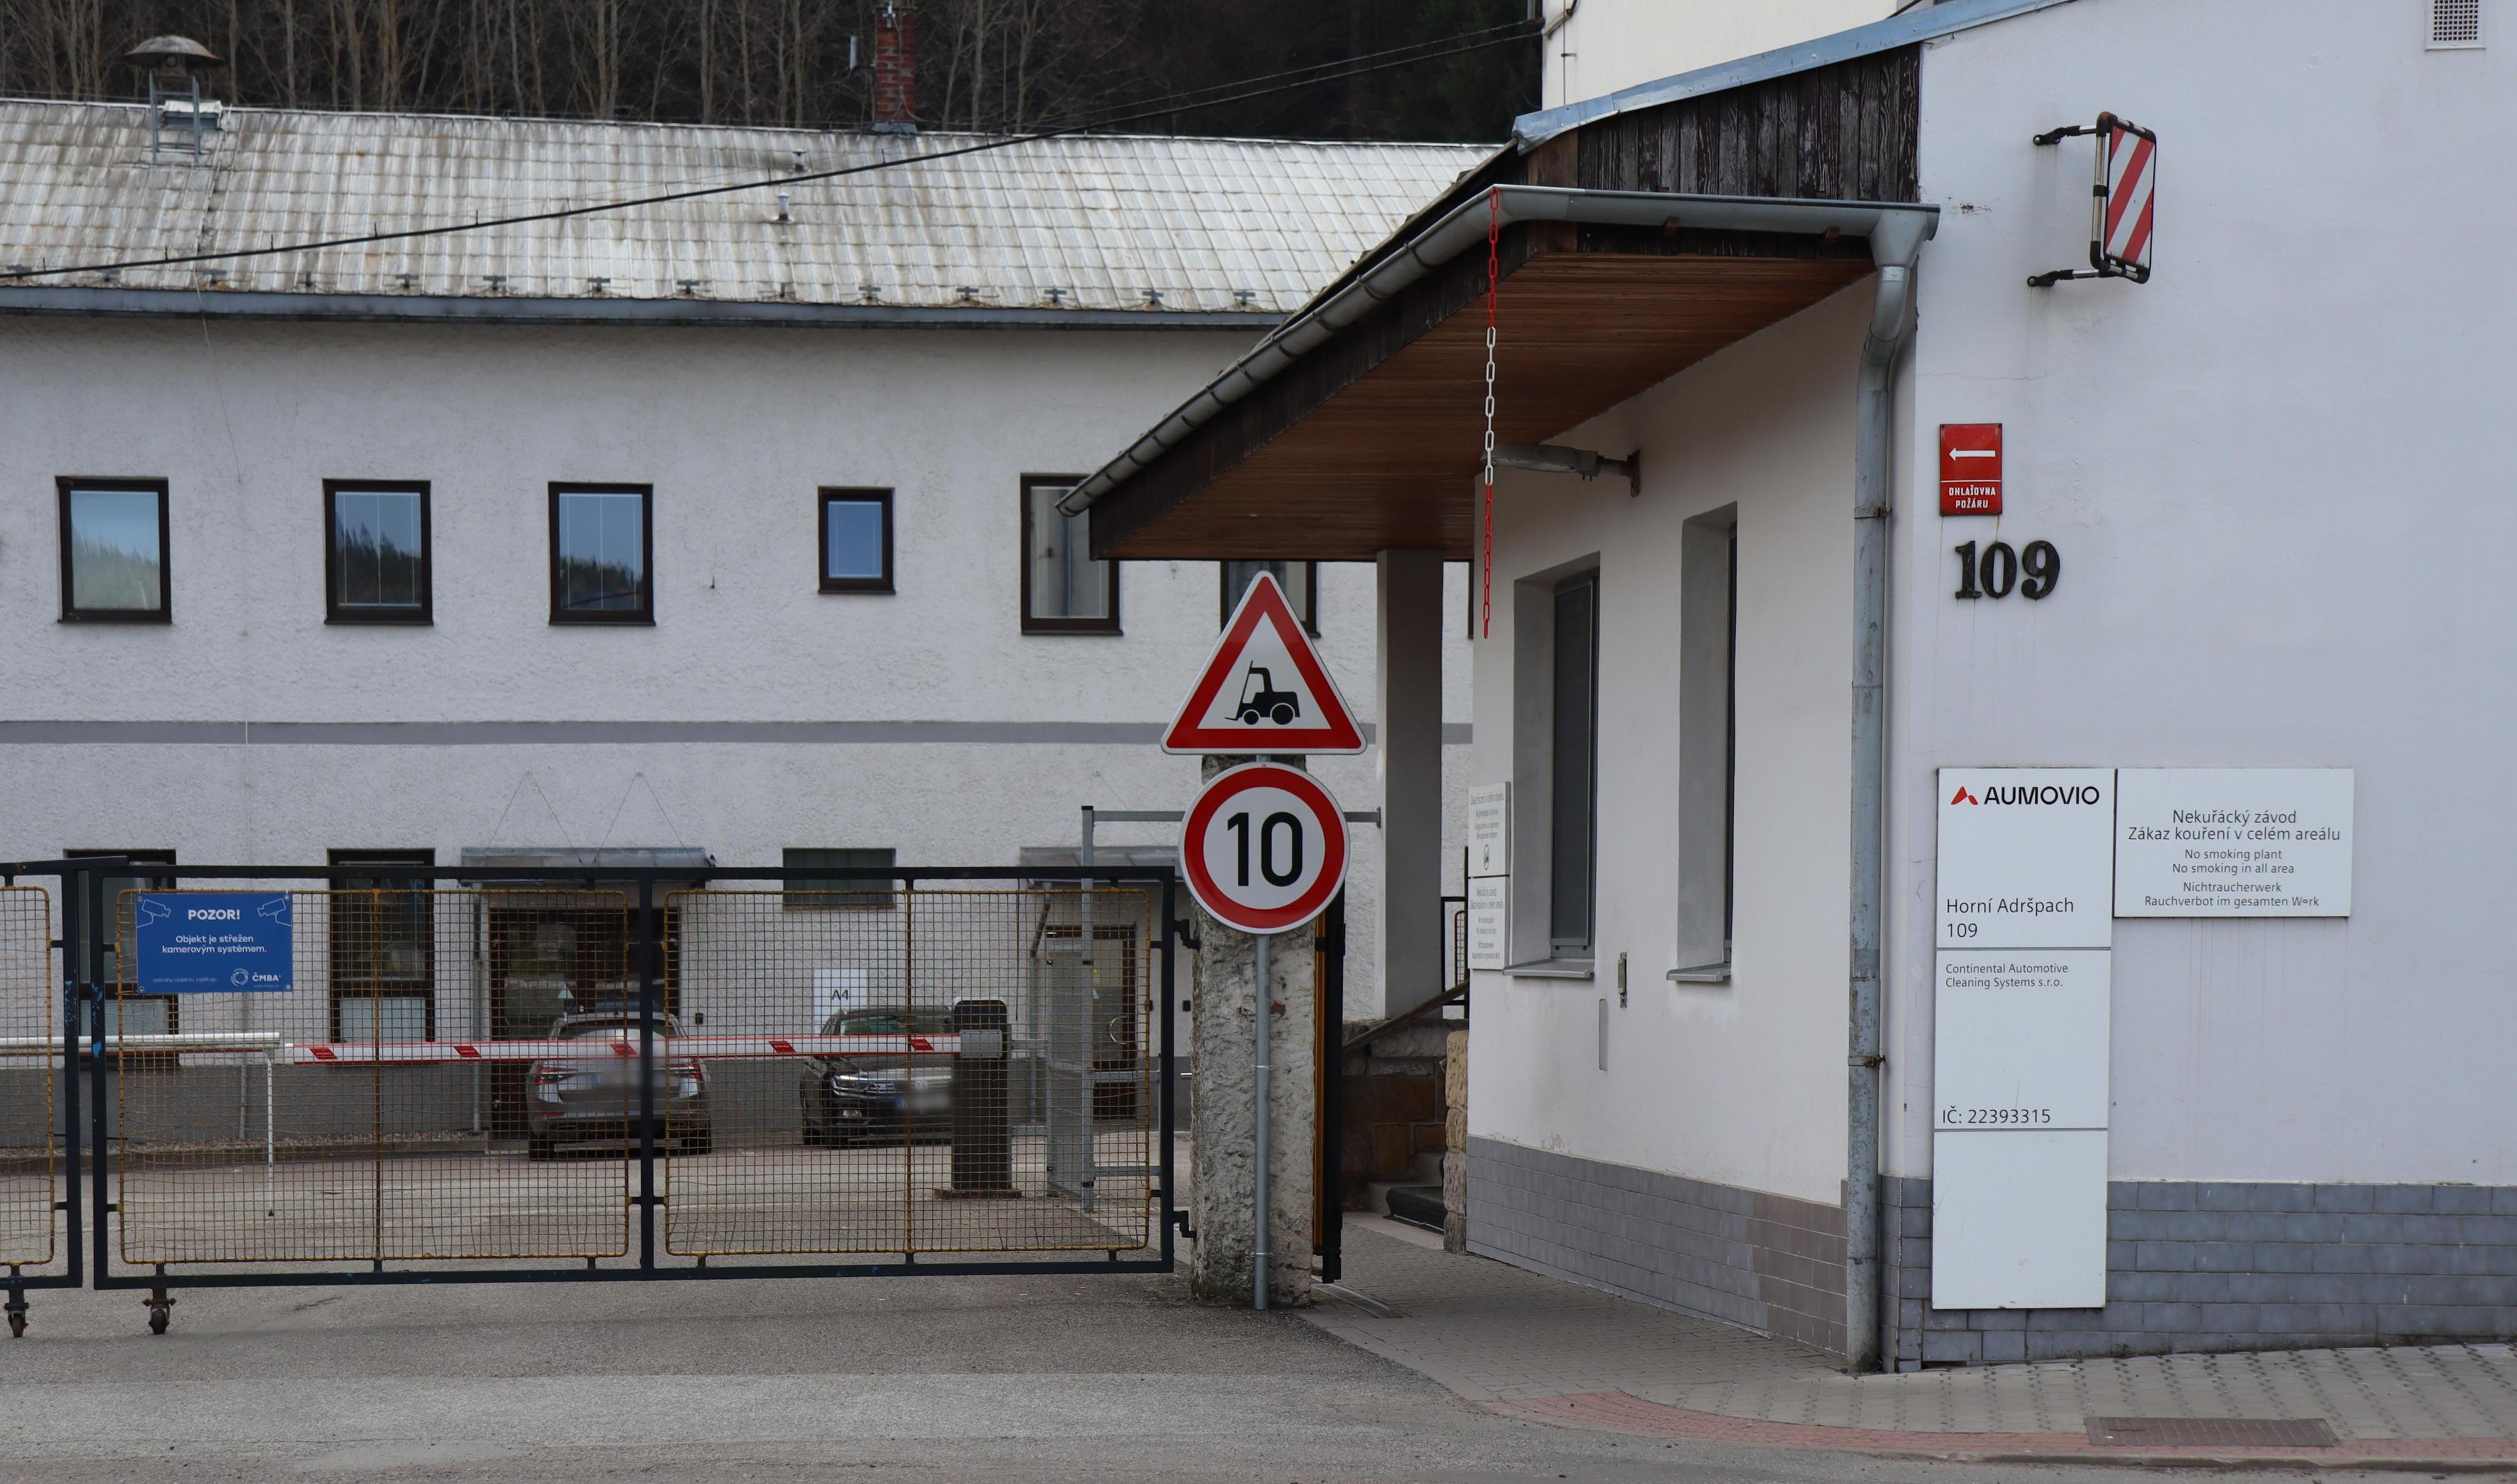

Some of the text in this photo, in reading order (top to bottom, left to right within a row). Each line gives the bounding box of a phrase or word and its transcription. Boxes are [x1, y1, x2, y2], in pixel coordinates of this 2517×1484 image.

[1949, 484, 1996, 496] OHLAŠOVNA
[1955, 497, 1988, 509] POŽÁRU
[1954, 540, 2061, 601] 109
[1983, 786, 2100, 805] AUMOVIO
[2173, 809, 2296, 827] Nekuřácký závod
[2128, 826, 2340, 840] Zákaz kouření v celém areálu
[1227, 812, 1303, 887] 10
[2185, 848, 2282, 862] No smoking plant
[2172, 862, 2294, 876] No smoking in all area
[2183, 881, 2282, 892] Nichtraucherwerk
[1947, 897, 2073, 917] Horní Adršpach
[2144, 895, 2214, 907] Rauchverbot
[2217, 895, 2231, 906] im
[2234, 896, 2288, 908] gesamten
[188, 909, 240, 920] POZOR!
[1948, 923, 1978, 938] 109
[176, 934, 254, 945] Objekt je střežen
[162, 944, 267, 955] kamerovým systémem.
[1946, 962, 2068, 974] Continental Automotive
[1946, 977, 2063, 990] Cleaning Systems s.r.o.
[1942, 1105, 2051, 1124] IČ: 22393315
